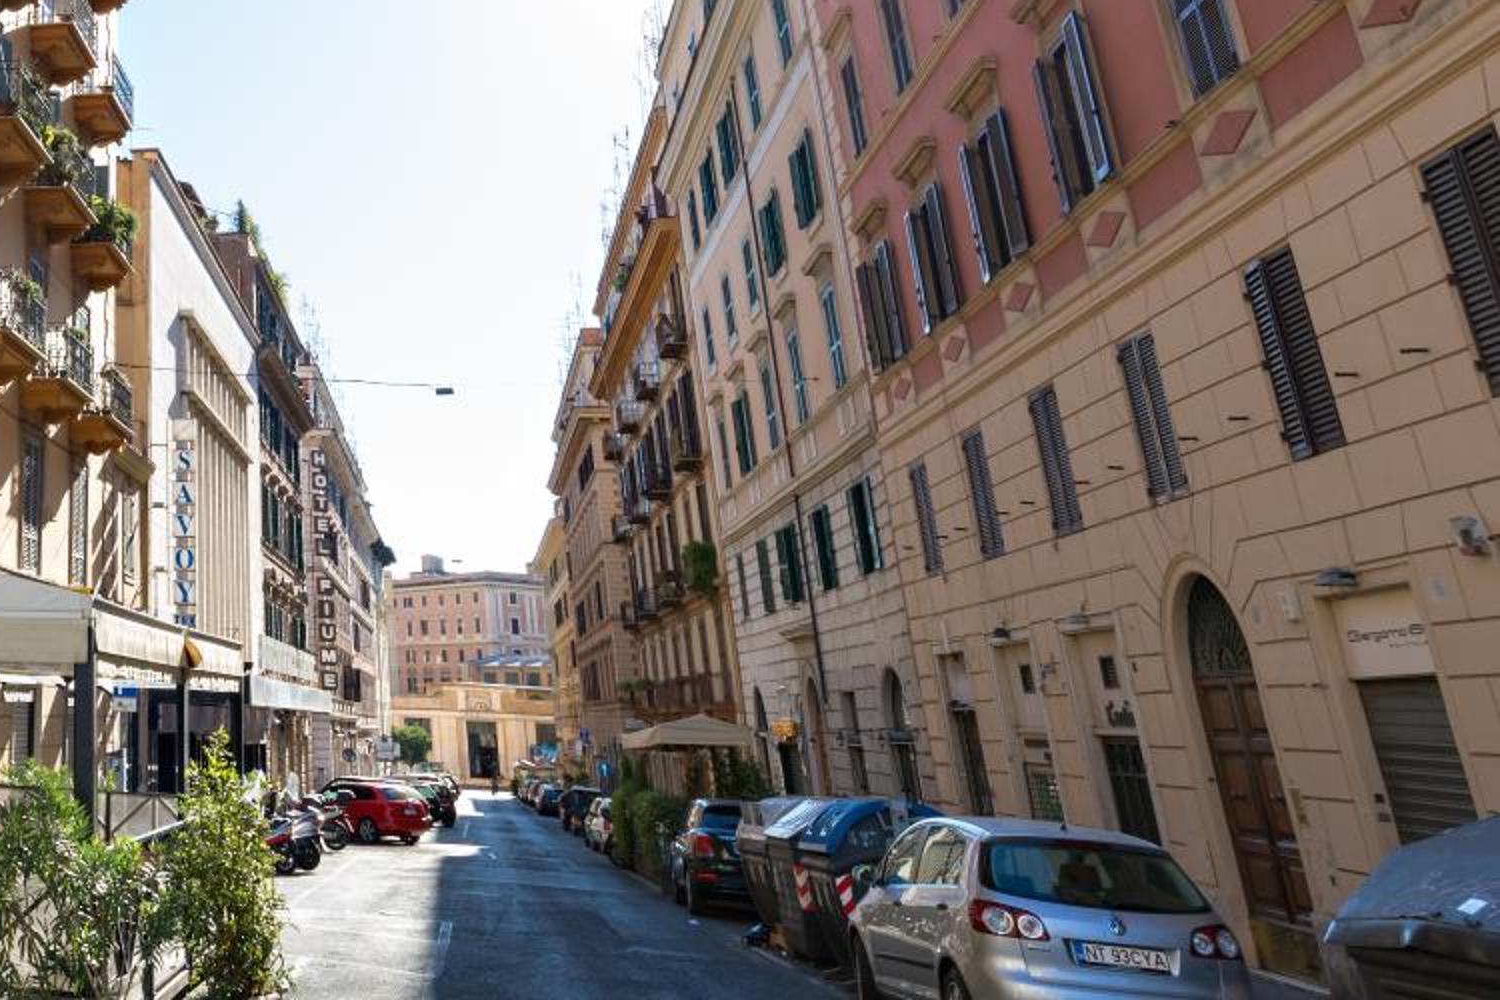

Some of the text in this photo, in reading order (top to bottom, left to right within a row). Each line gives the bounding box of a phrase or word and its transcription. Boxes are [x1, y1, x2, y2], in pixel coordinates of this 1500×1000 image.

[174, 451, 194, 603] SAVOY
[312, 450, 337, 690] HOTEL FIUME
